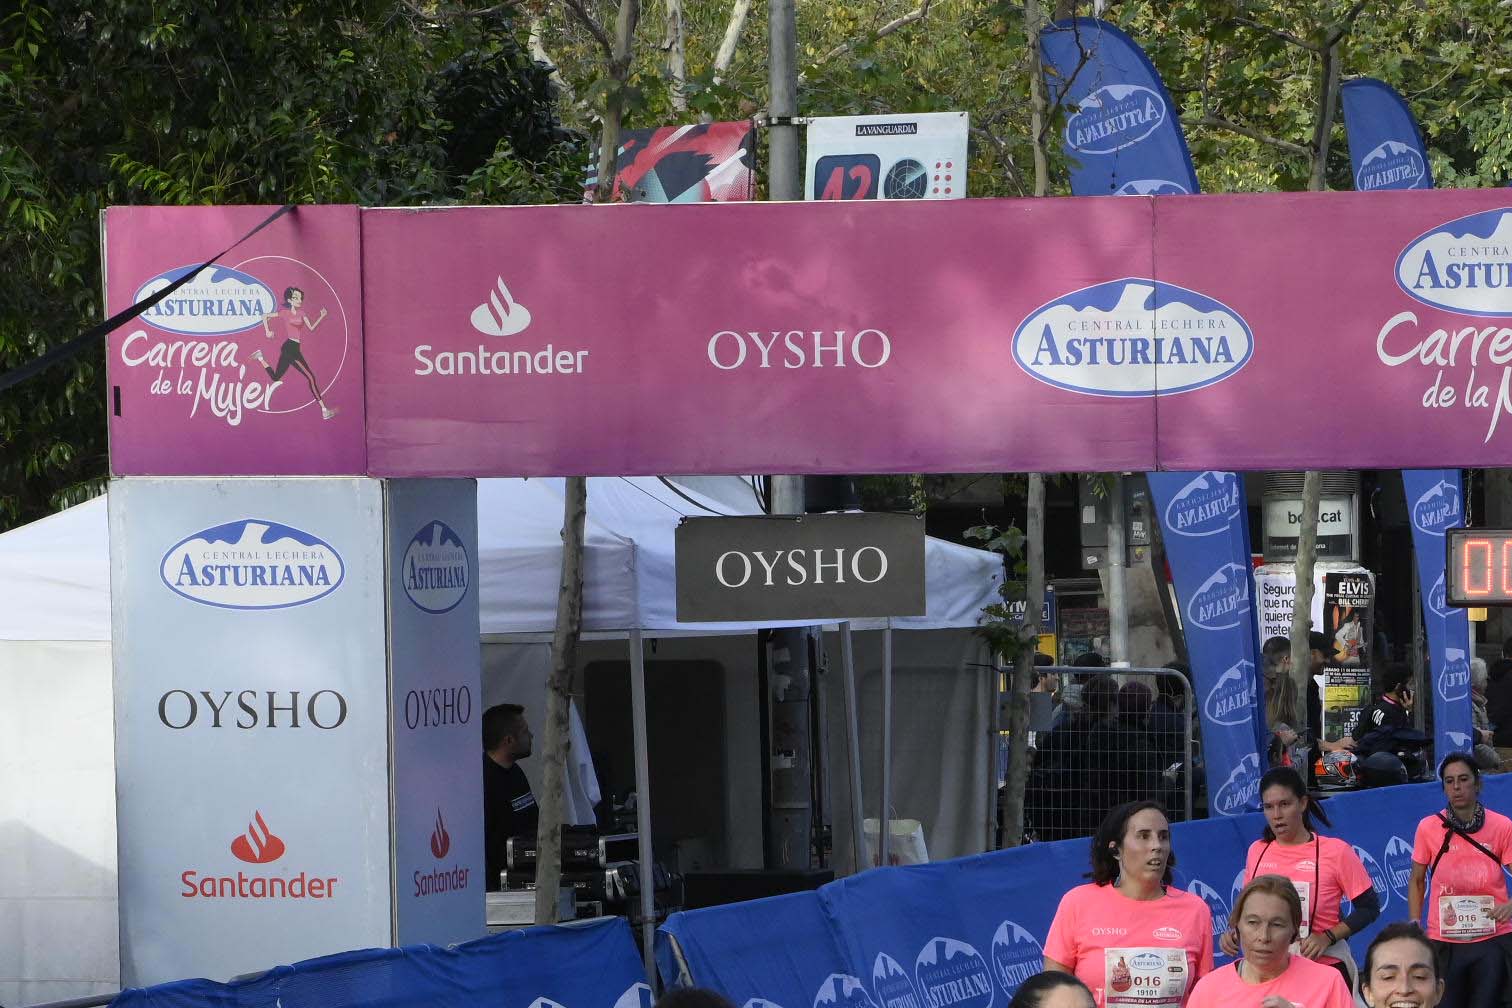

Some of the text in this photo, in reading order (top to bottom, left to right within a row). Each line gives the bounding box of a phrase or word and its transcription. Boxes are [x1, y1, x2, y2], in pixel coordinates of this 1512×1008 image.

[143, 290, 265, 317] ASTURIANA
[1068, 318, 1227, 332] CENTRAL LECHERA
[121, 331, 238, 369] Carrera
[415, 344, 588, 376] Santander
[707, 328, 892, 370] OYSHO
[1031, 323, 1234, 367] ASTURIANA
[150, 363, 283, 426] de la Mujer
[1422, 370, 1456, 409] de
[1464, 369, 1489, 408] la
[175, 553, 331, 587] ASTURIANA
[202, 551, 325, 561] CENTRAL LECHERA
[715, 546, 889, 588] OYSHO
[408, 563, 466, 592] ASTURIANA
[1338, 581, 1369, 595] ELVIS
[1264, 598, 1281, 611] que
[1264, 611, 1294, 625] quiere
[157, 689, 347, 730] OYSHO
[405, 685, 472, 730] OYSHO
[181, 870, 338, 899] Santander
[413, 864, 470, 897] Santander
[1092, 927, 1127, 937] OYSHO
[1134, 976, 1161, 987] 016
